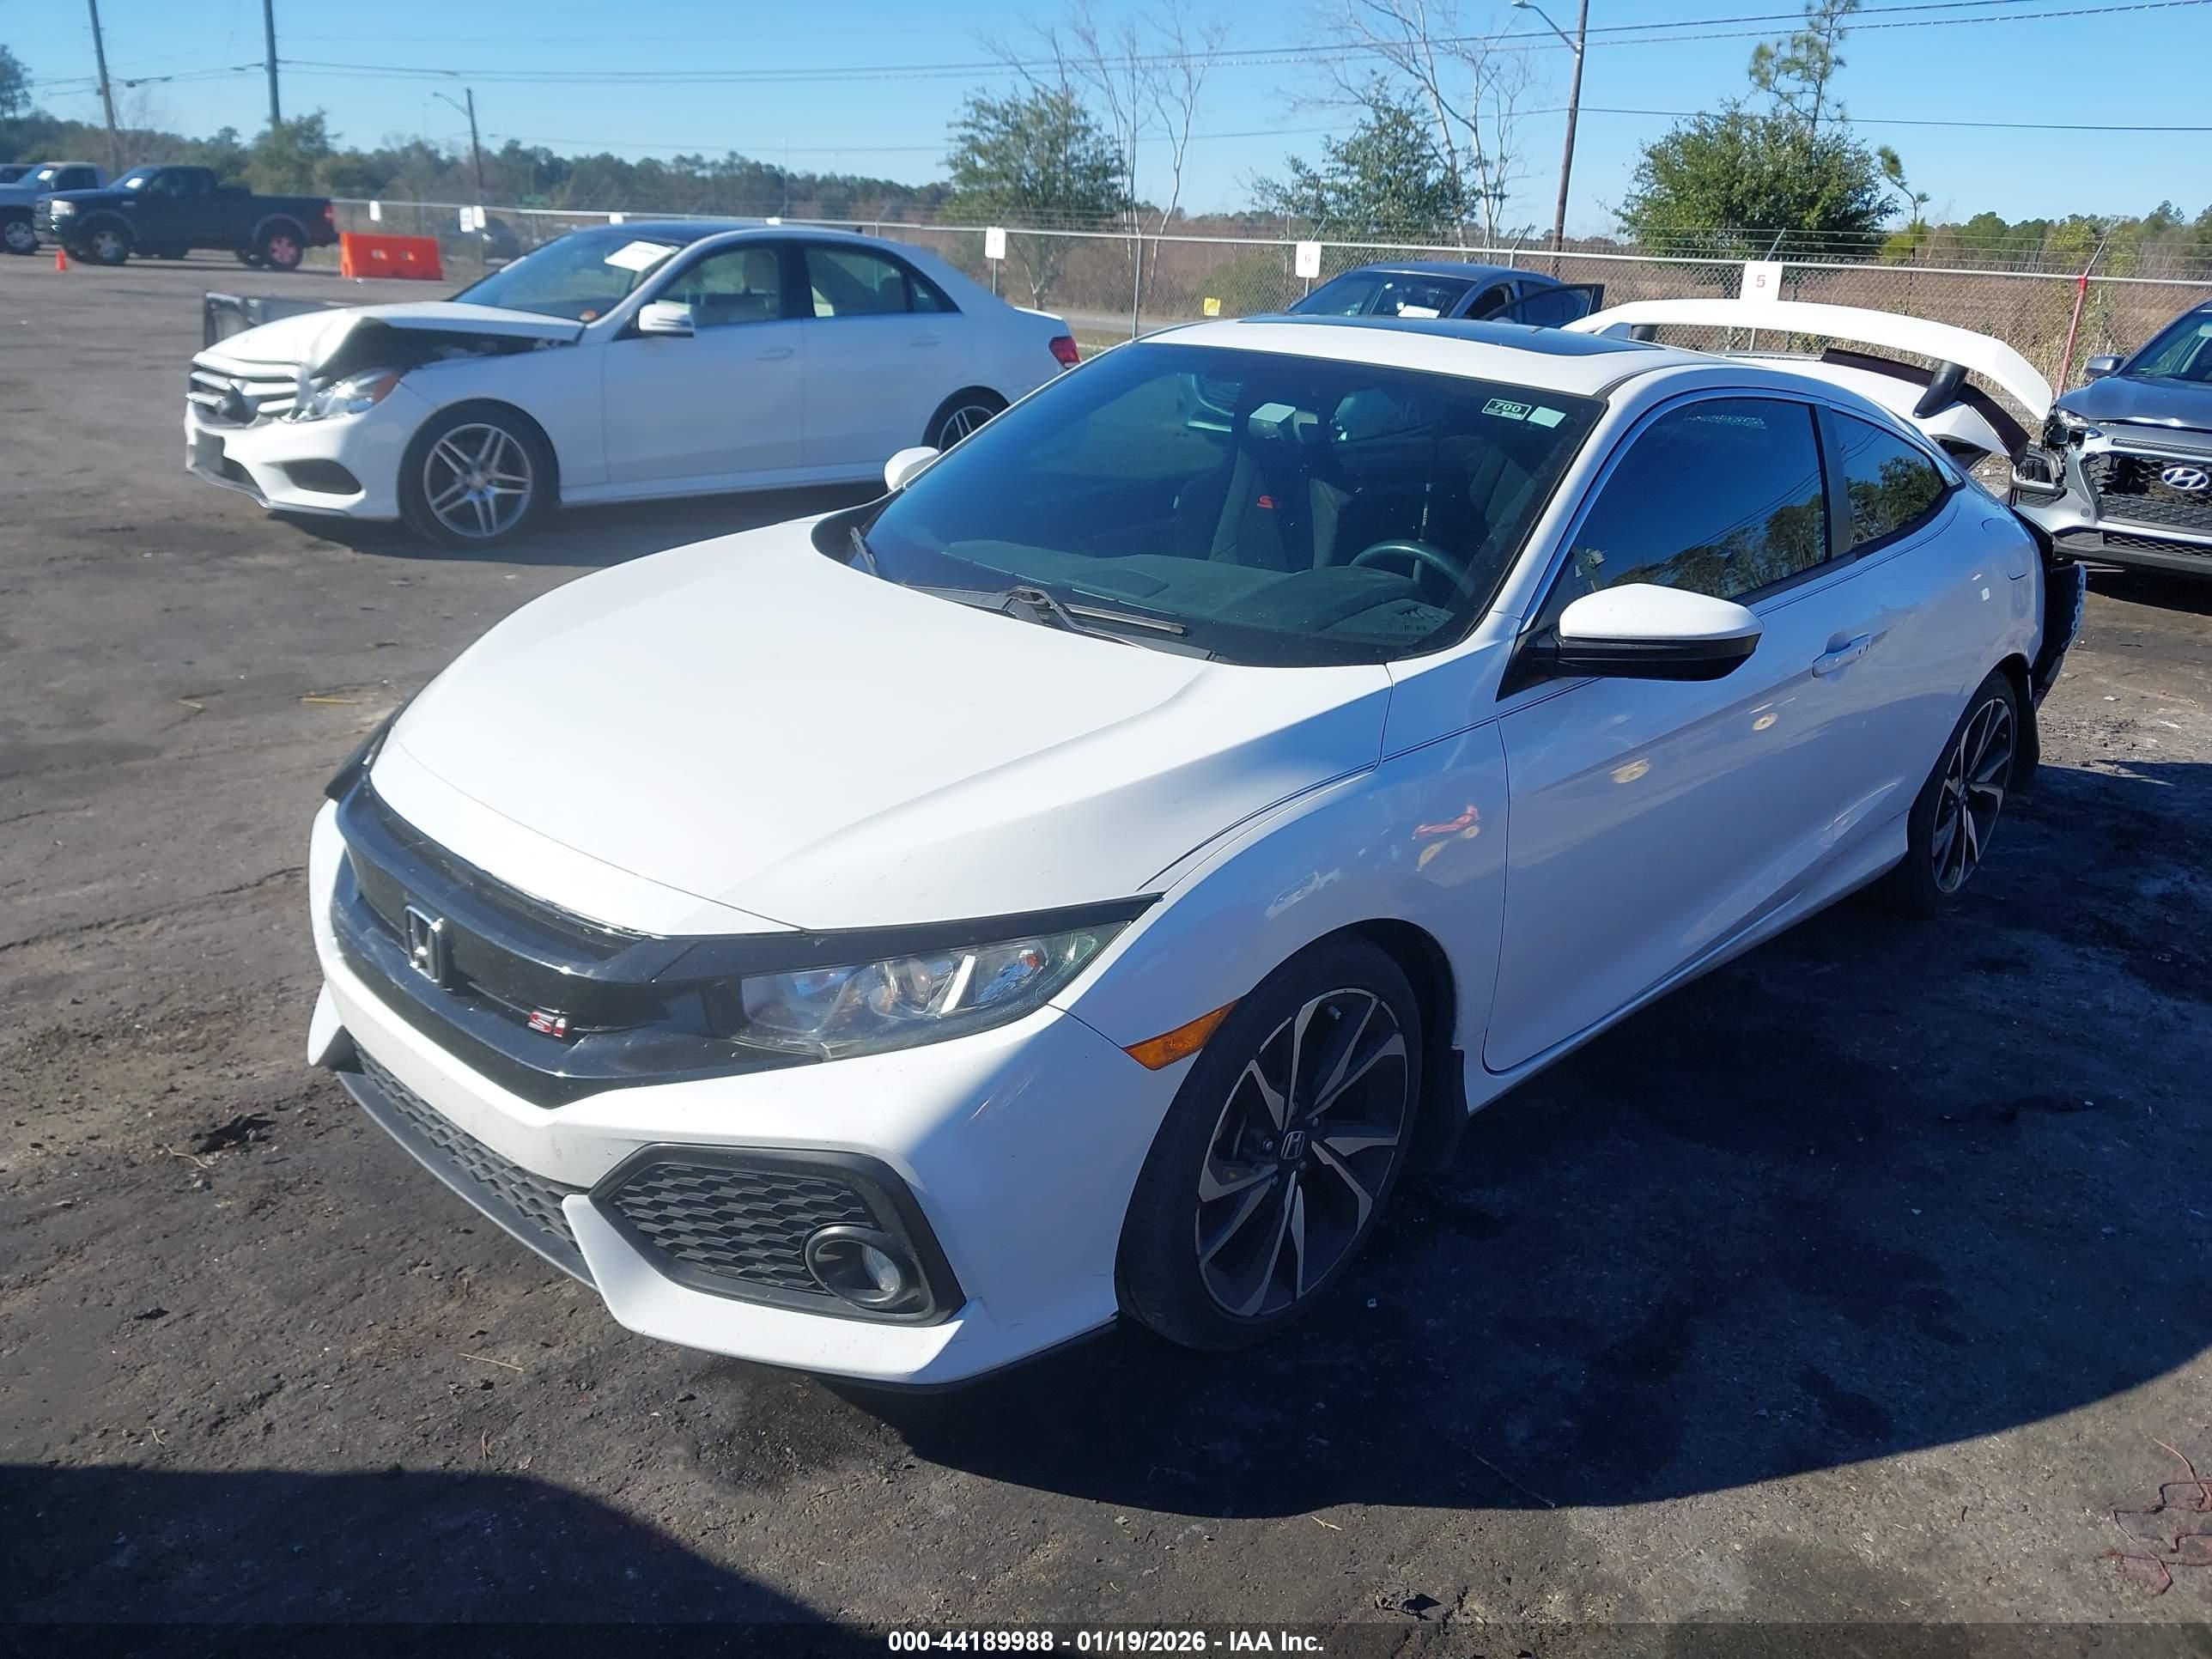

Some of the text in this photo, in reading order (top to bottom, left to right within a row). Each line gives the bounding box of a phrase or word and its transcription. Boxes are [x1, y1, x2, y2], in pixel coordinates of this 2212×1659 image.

[1756, 274, 1766, 289] 5
[1494, 402, 1522, 413] 700
[527, 1011, 567, 1038] Si
